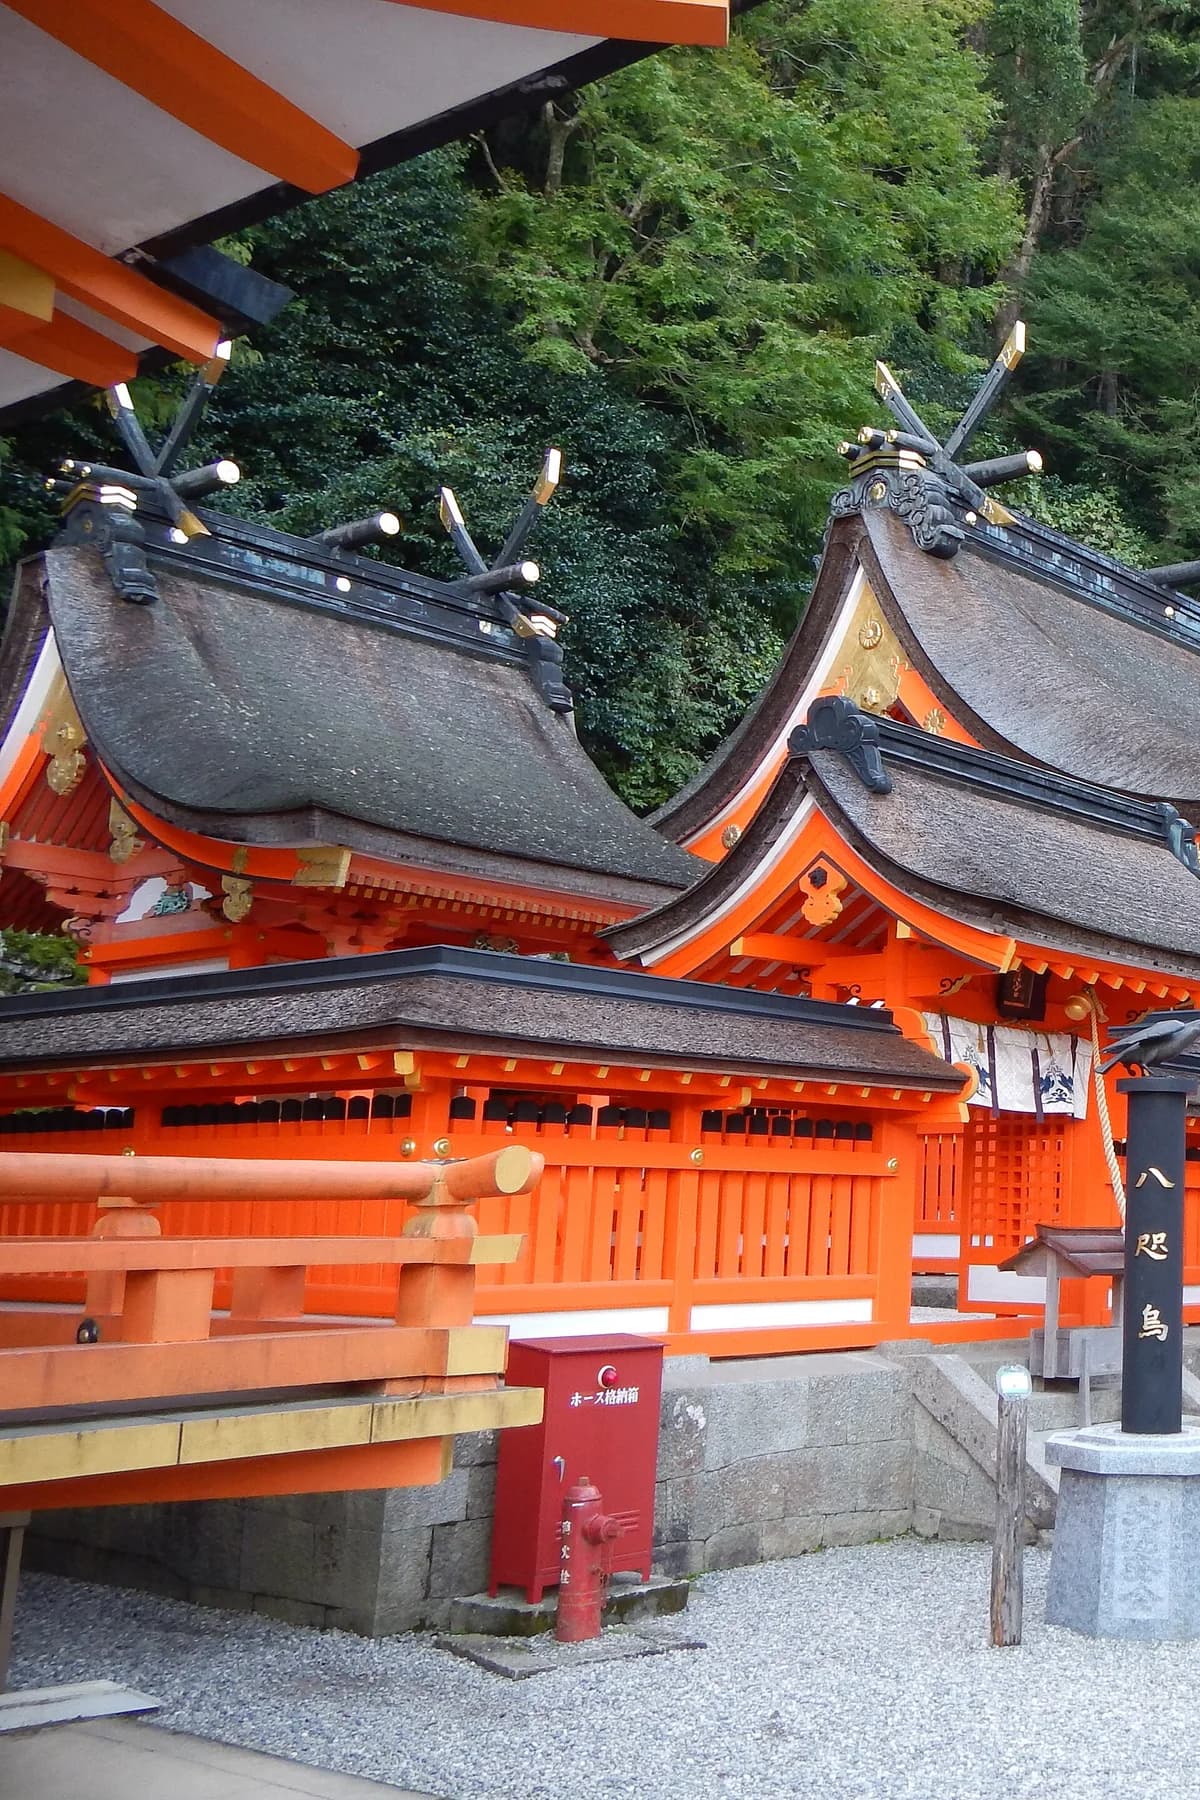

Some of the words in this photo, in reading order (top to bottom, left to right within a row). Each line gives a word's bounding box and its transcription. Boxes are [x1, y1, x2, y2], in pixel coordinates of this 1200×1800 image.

[570, 1387, 639, 1406] ホース格納箱
